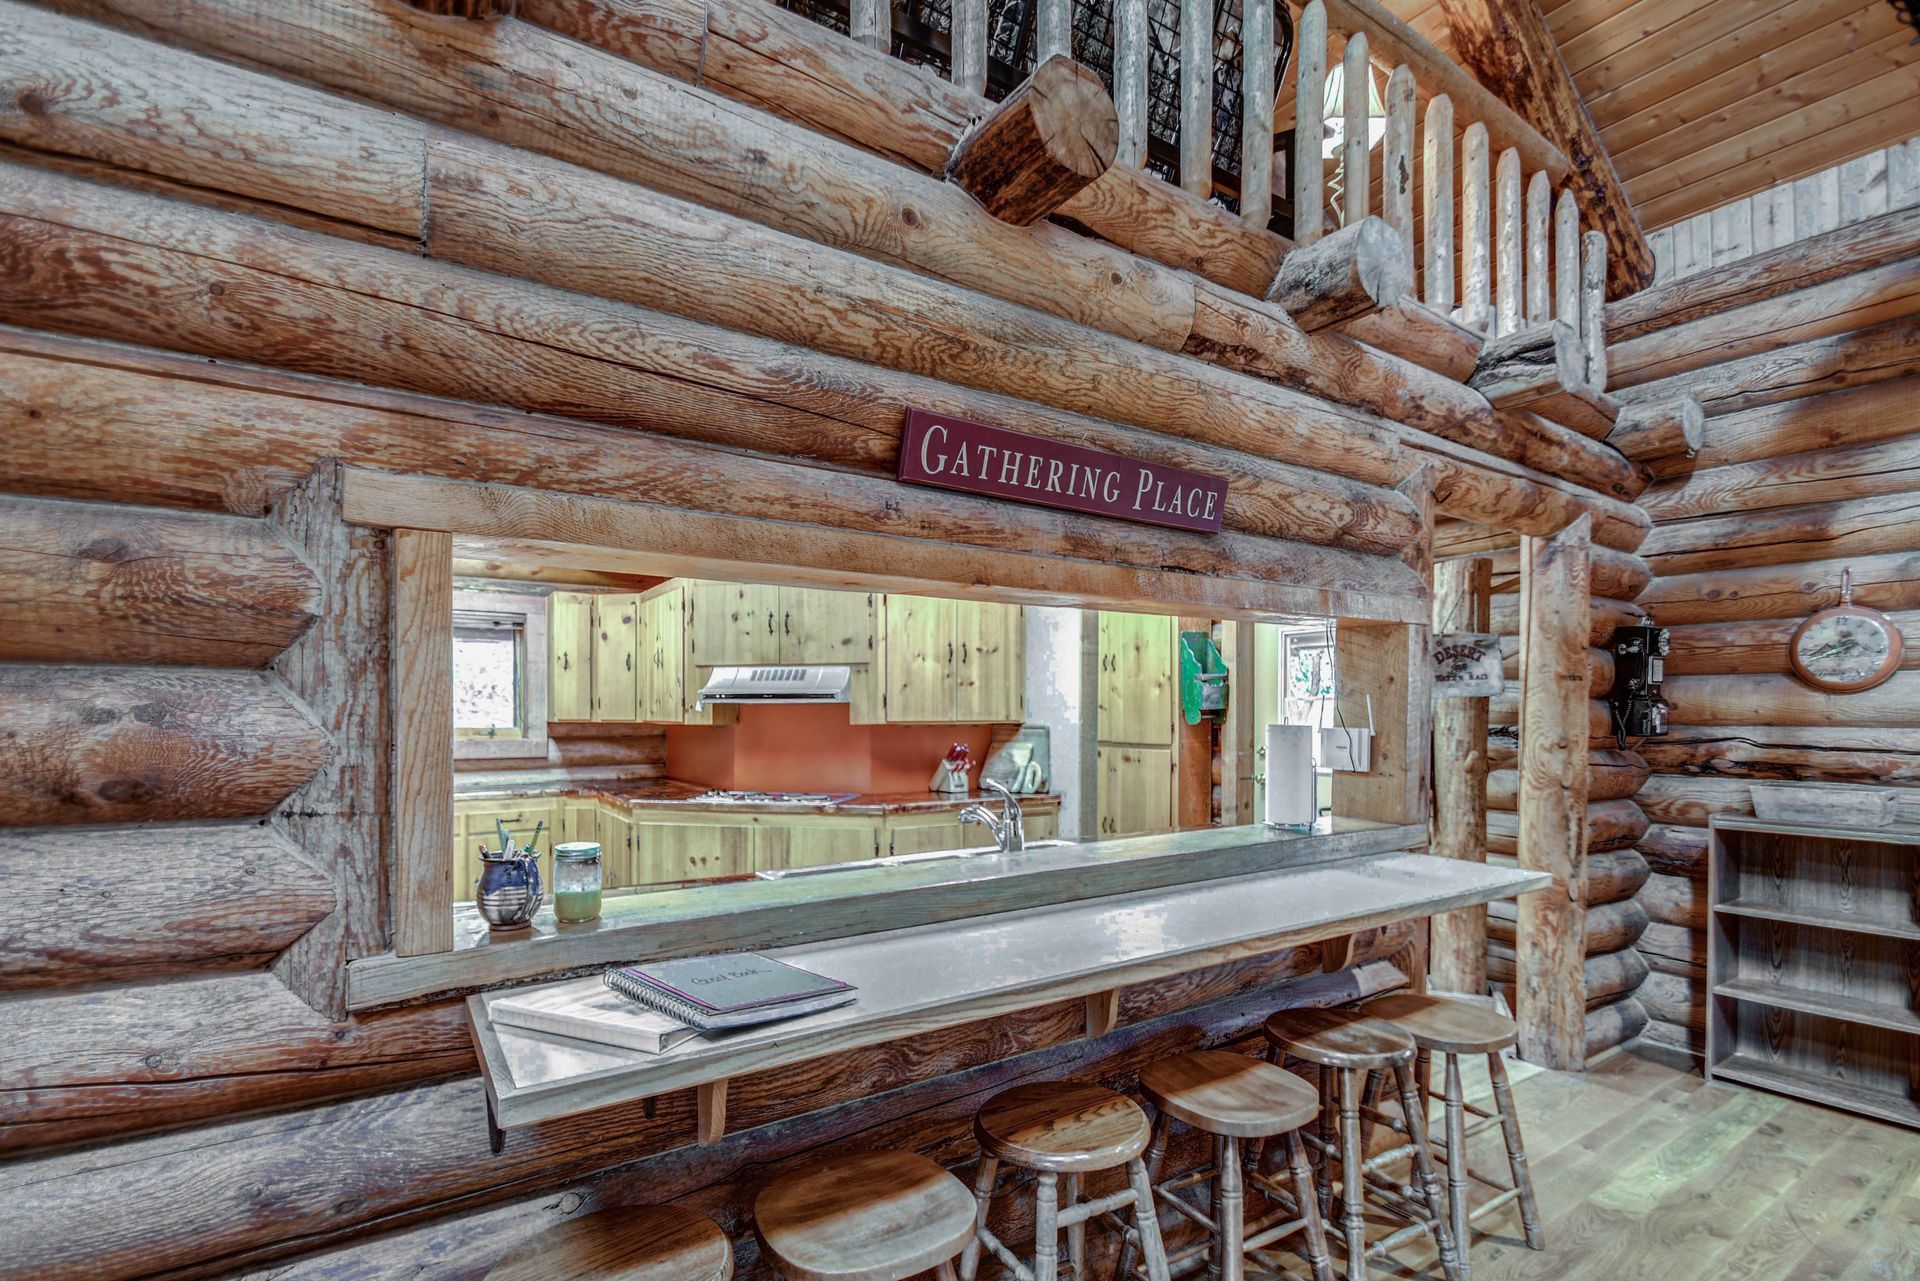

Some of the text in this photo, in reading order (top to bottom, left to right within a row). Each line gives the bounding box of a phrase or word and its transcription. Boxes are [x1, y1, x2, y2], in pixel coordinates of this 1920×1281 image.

[920, 424, 1219, 521] GATHERING PLACE
[1432, 644, 1487, 665] DESERT
